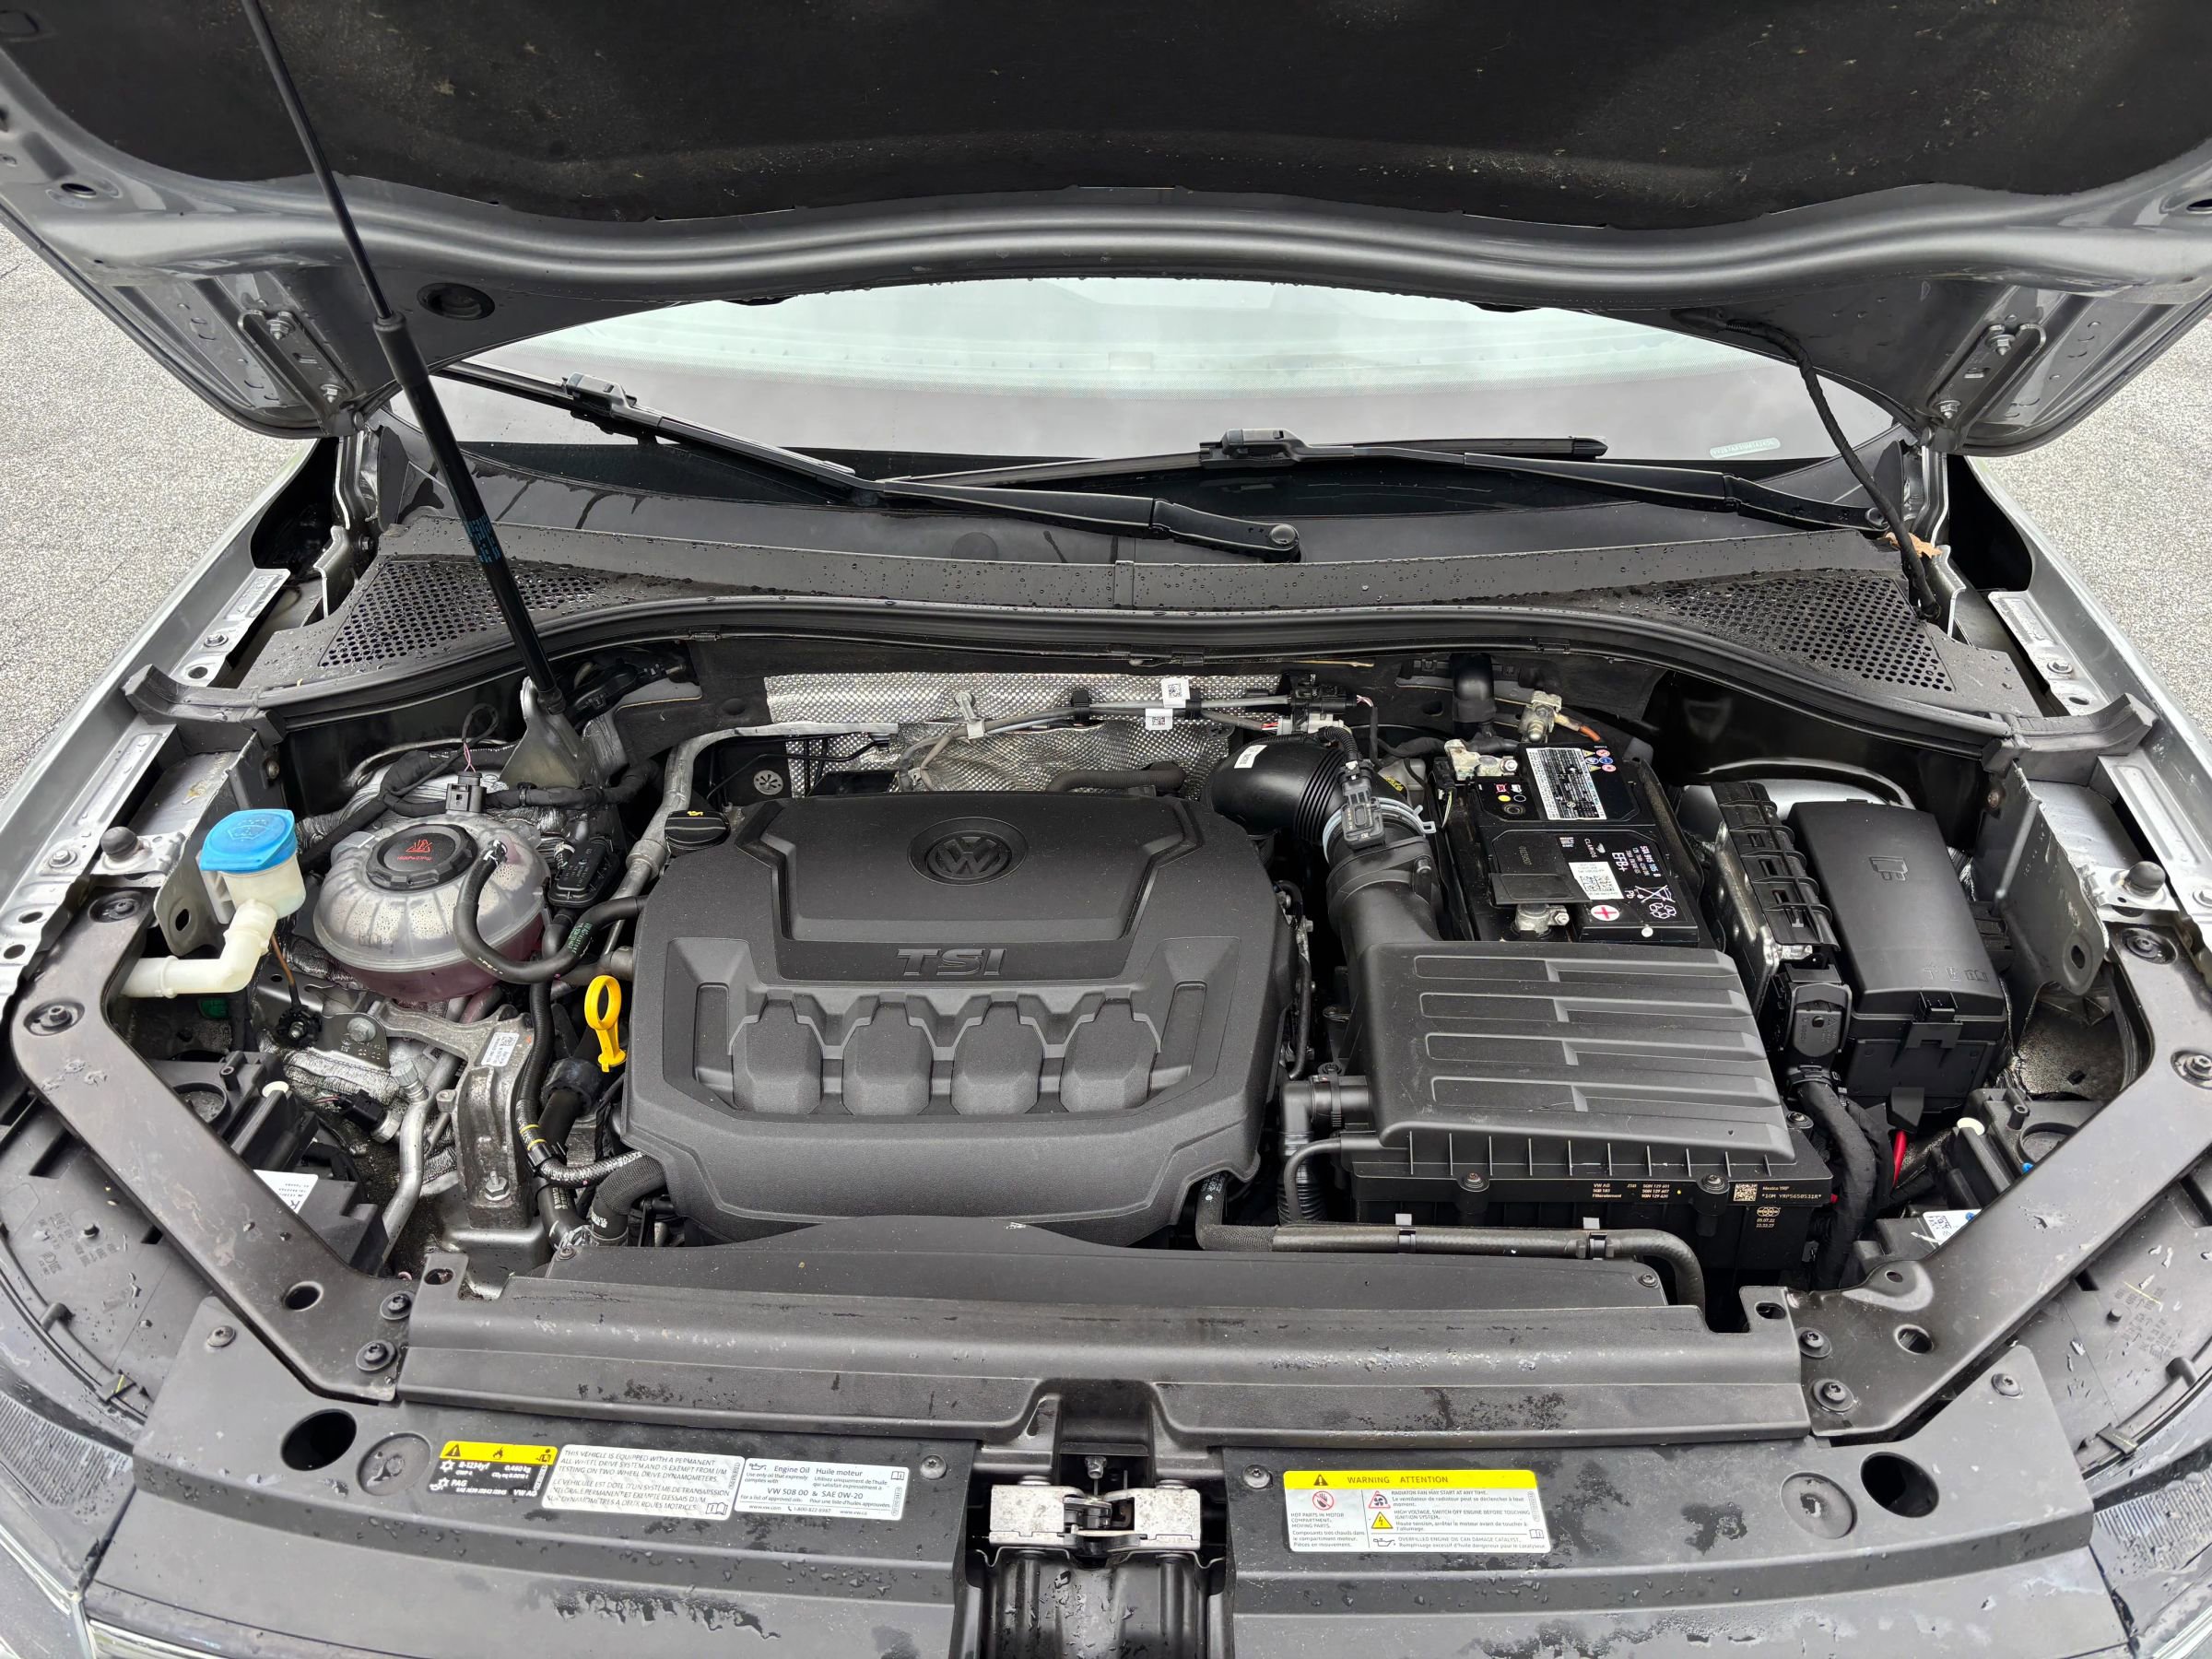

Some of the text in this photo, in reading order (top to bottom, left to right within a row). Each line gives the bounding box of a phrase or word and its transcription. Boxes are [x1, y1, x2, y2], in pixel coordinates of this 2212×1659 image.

[1612, 852, 1629, 872] EFB+
[1624, 890, 1635, 899] Pb
[897, 948, 1007, 976] TSI
[774, 1465, 798, 1474] Engine
[450, 1479, 468, 1487] PAG
[837, 1491, 863, 1499] 0W-20
